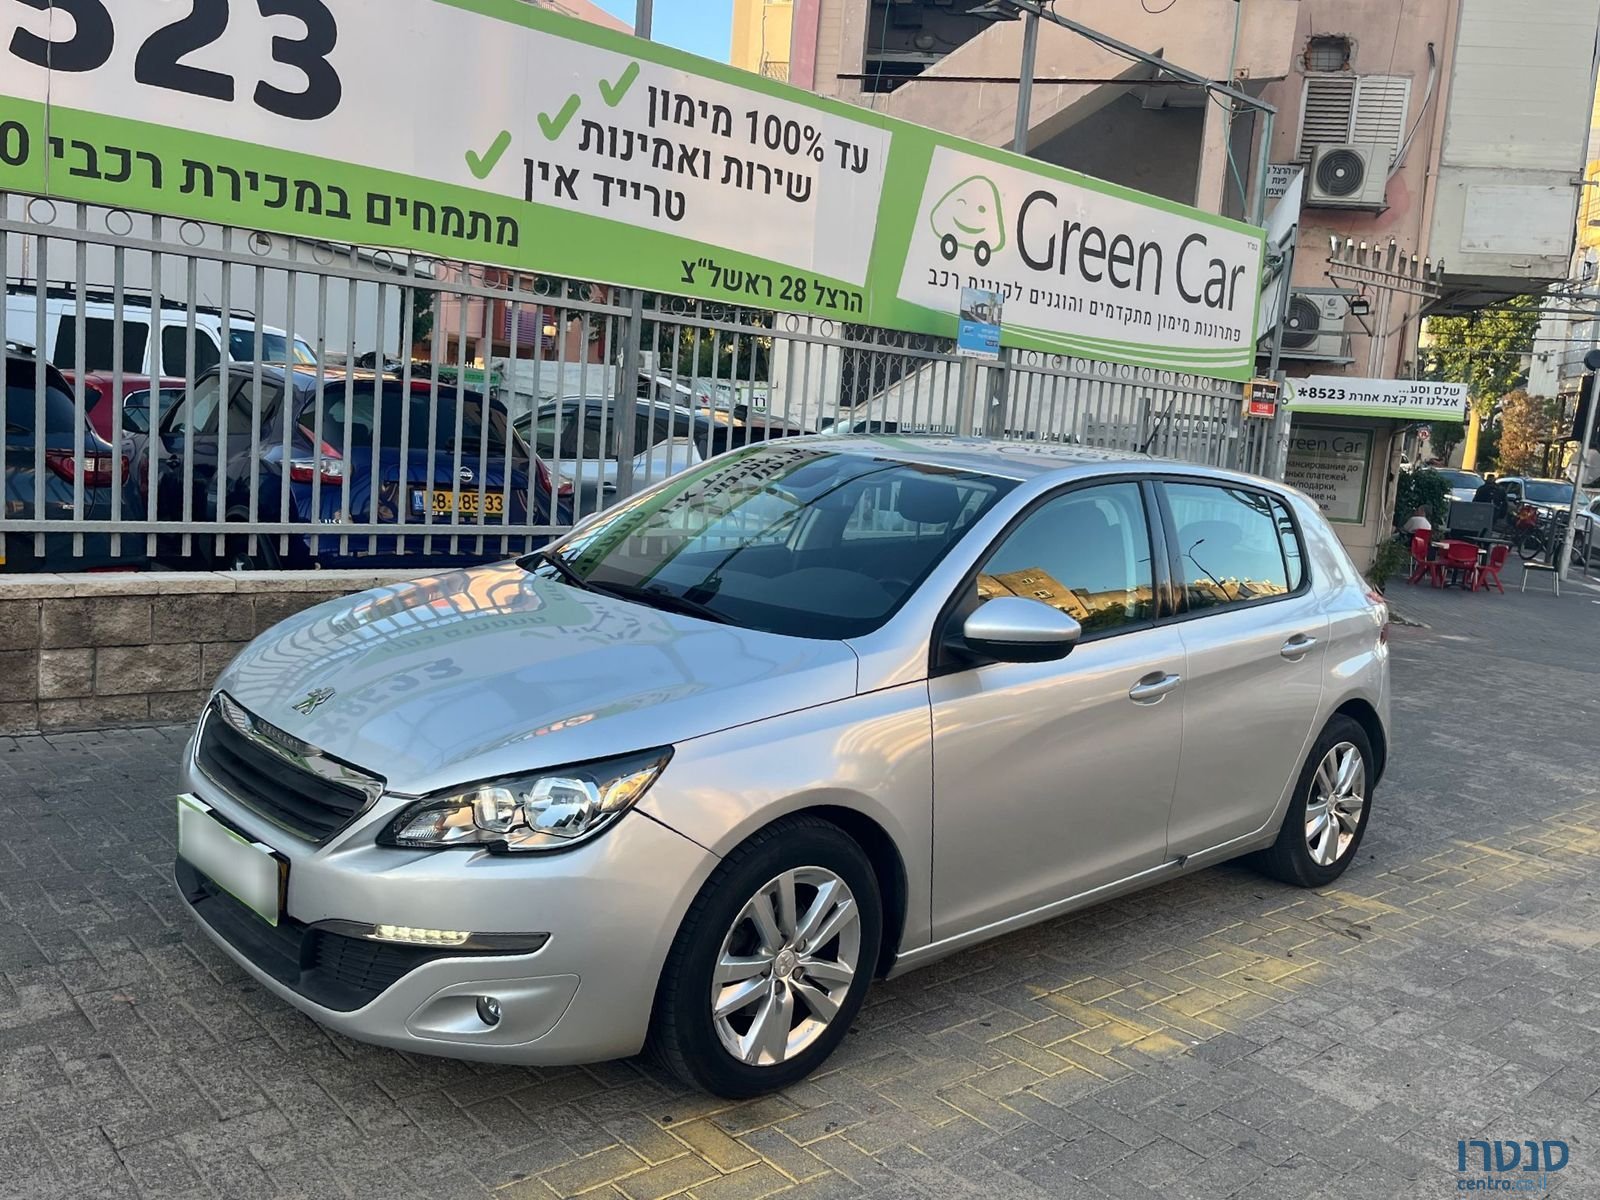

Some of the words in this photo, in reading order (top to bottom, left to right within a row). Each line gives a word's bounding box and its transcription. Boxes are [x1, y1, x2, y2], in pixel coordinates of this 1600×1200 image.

[648, 86, 733, 138] מימון
[579, 119, 710, 180] ואמינות
[746, 110, 824, 162] 100%
[49, 136, 162, 189] רכבי
[834, 139, 869, 174] עד
[180, 159, 351, 220] במכירת
[524, 158, 579, 202] אין
[721, 155, 811, 203] שירות
[593, 172, 685, 222] טרייד
[366, 192, 519, 247] מתמחים
[1016, 190, 1163, 296] Green
[1176, 233, 1246, 311] Car
[780, 274, 807, 302] 28
[928, 268, 960, 289] רכב
[814, 279, 863, 313] הרצל
[1030, 288, 1083, 313] והוגנים
[1089, 302, 1152, 326] מתקדמים
[1157, 312, 1190, 334] מימון
[1194, 321, 1241, 343] פתרונות
[1349, 393, 1379, 403] אחרת
[1383, 394, 1407, 406] קצת
[1410, 395, 1422, 405] זה
[1426, 396, 1459, 406] אצלנו
[1433, 385, 1460, 396] שלם
[1288, 438, 1327, 451] reen
[1332, 437, 1362, 453] Car
